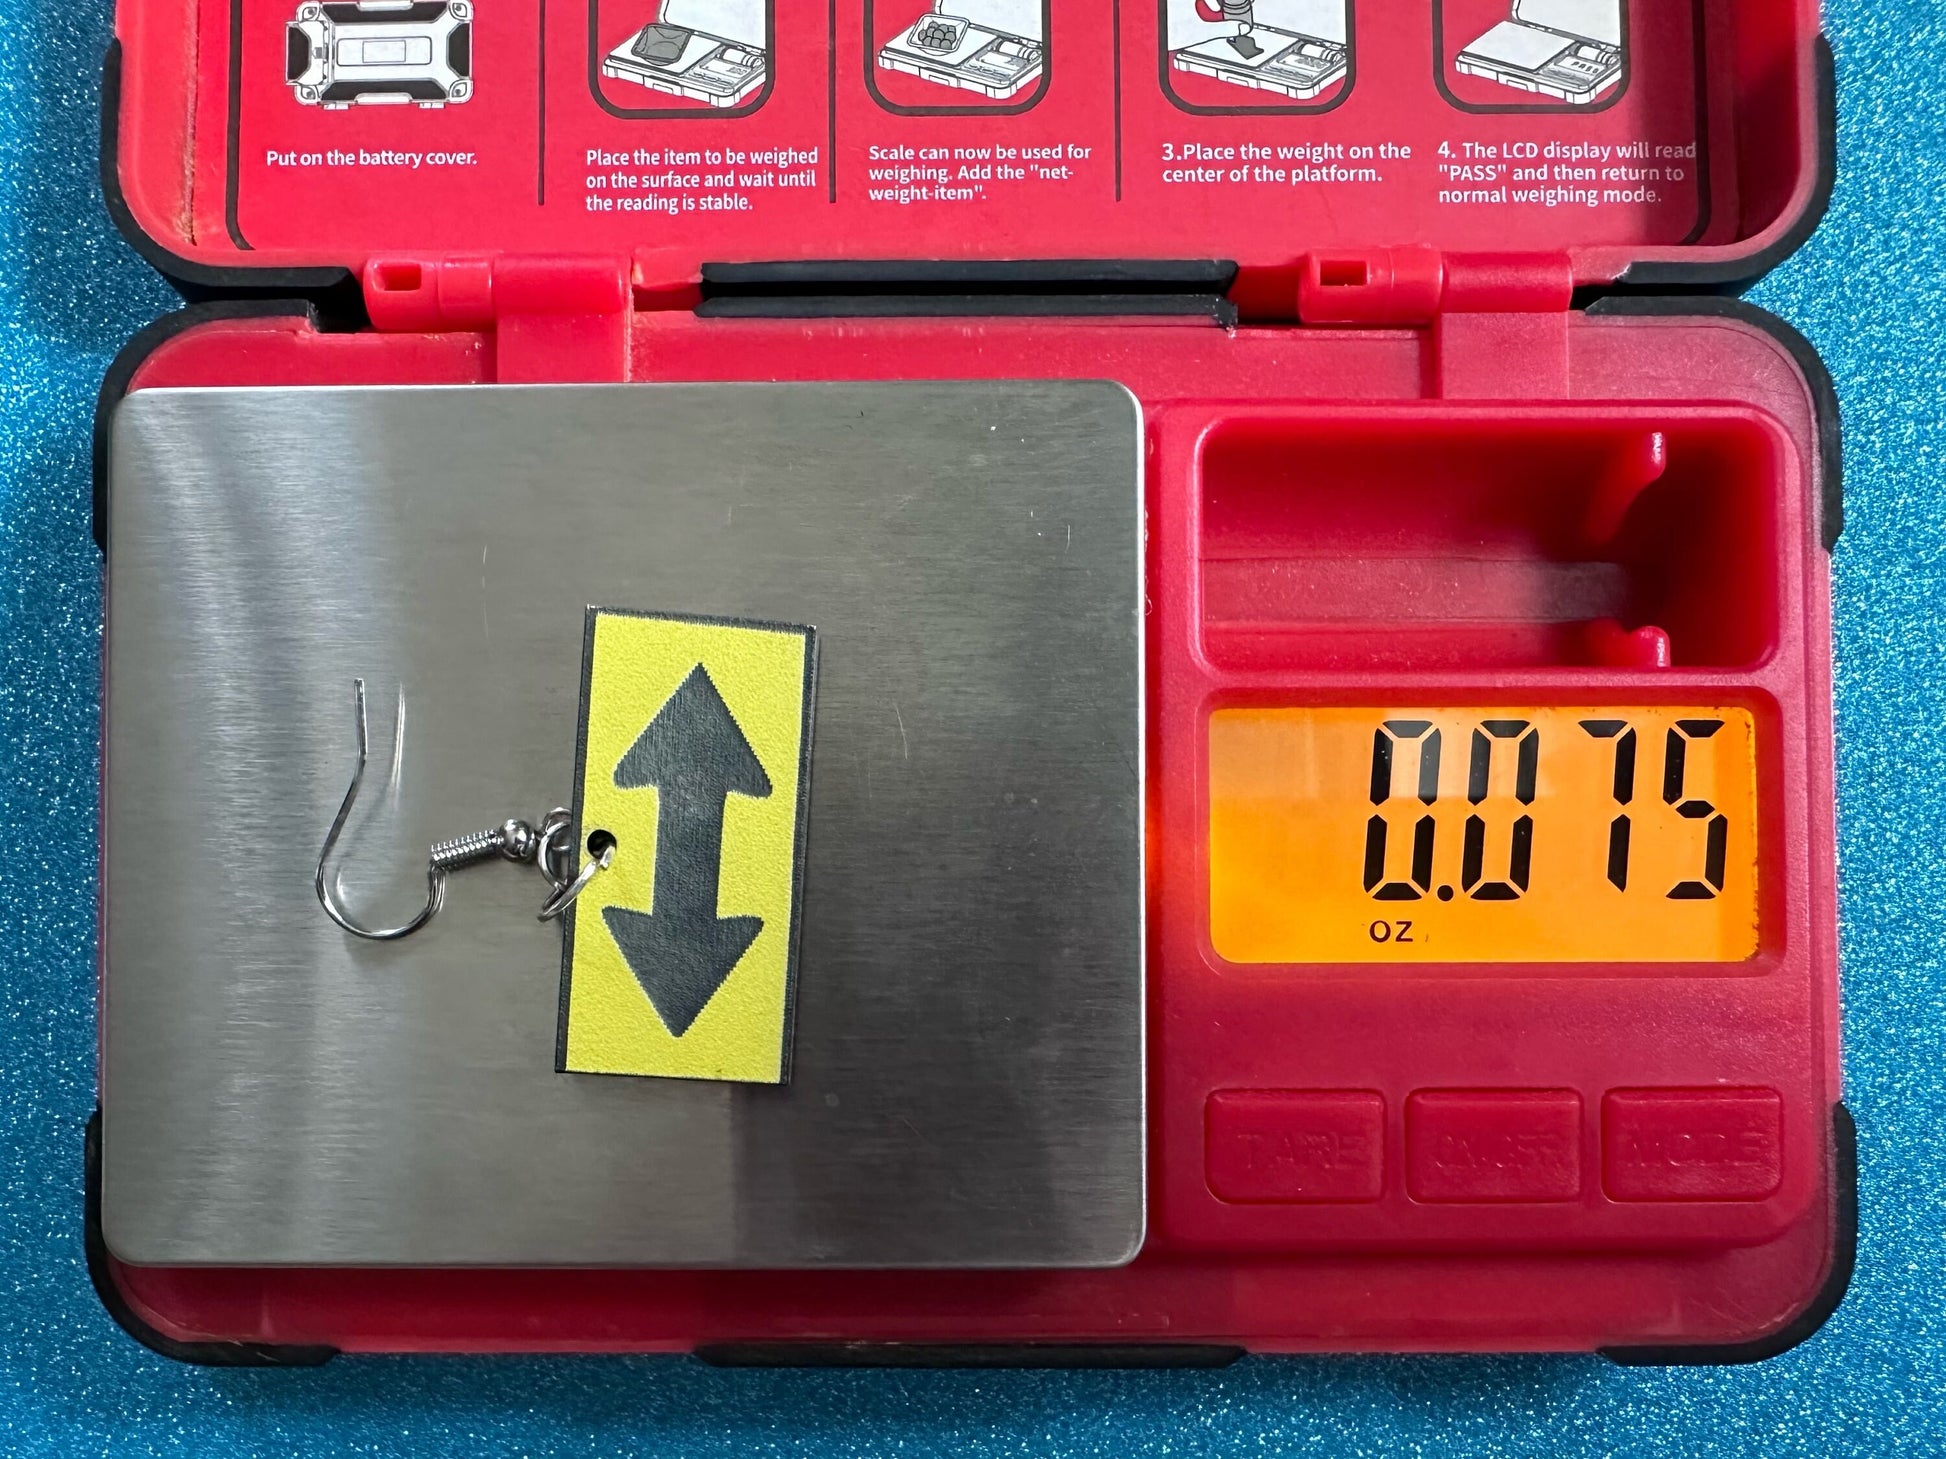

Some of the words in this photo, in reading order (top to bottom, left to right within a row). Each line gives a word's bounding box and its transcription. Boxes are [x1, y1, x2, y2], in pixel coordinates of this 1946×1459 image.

[266, 150, 298, 167] Put
[299, 152, 323, 167] on
[325, 148, 356, 166] the
[358, 148, 424, 170] battery
[425, 151, 478, 166] cover.
[586, 147, 630, 166] Place
[632, 147, 661, 166] the
[663, 147, 701, 166] item
[704, 148, 722, 166] to
[725, 146, 746, 165] be
[749, 145, 819, 169] weighed
[868, 143, 916, 161] Scale
[918, 147, 950, 161] can
[953, 147, 992, 160] now
[995, 143, 1018, 160] be
[1021, 143, 1063, 160] used
[1066, 143, 1093, 160] for
[1239, 142, 1273, 161] the
[1276, 141, 1345, 164] weight
[1348, 145, 1374, 160] on
[1378, 141, 1412, 160] the
[1436, 140, 1457, 159] 4.
[1461, 141, 1498, 159] The
[1502, 141, 1539, 159] LCD
[1542, 140, 1612, 163] display
[1615, 140, 1650, 159] will
[1654, 139, 1697, 162] read
[585, 175, 607, 189] on
[610, 170, 638, 189] the
[641, 170, 701, 189] surface
[703, 169, 735, 188] and
[738, 169, 775, 188] wait
[778, 168, 817, 188] until
[868, 164, 953, 185] weighing.
[957, 163, 992, 181] Add
[995, 163, 1026, 180] the
[1029, 163, 1074, 180] "net-
[1161, 166, 1226, 183] center
[1228, 164, 1250, 183] of
[1252, 164, 1286, 183] the
[1291, 163, 1383, 187] platform.
[1438, 163, 1507, 182] "PASS"
[1512, 163, 1548, 181] and
[1552, 163, 1597, 181] then
[1601, 165, 1660, 182] return
[1664, 165, 1685, 182] to
[585, 193, 613, 212] the
[616, 192, 680, 216] reading
[682, 192, 696, 211] is
[698, 192, 754, 211] stable.
[868, 184, 987, 205] weight-item".
[1438, 185, 1508, 204] normal
[1511, 184, 1599, 208] weighing
[1601, 184, 1662, 204] mode.
[1363, 720, 1728, 902] 0.075
